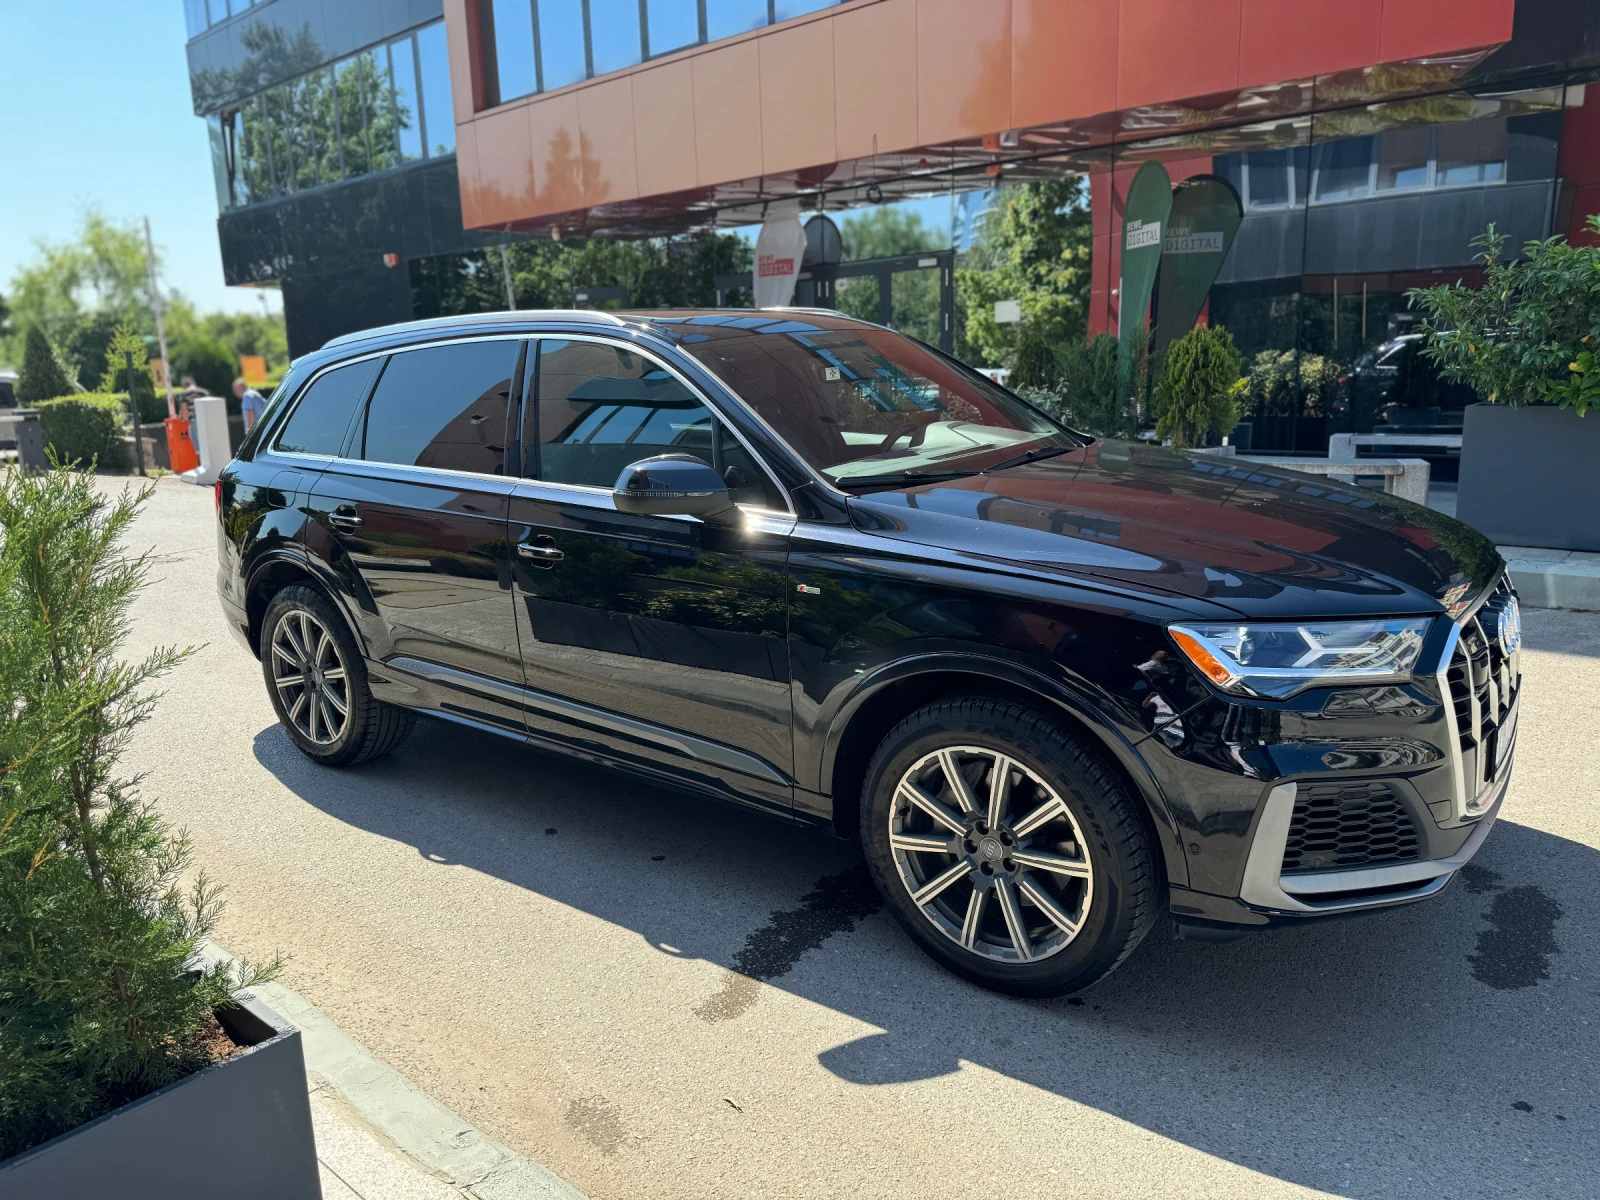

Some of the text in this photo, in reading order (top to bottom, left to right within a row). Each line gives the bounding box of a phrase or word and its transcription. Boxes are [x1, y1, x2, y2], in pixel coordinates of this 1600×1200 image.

[1126, 219, 1142, 231] REWE
[1127, 230, 1159, 247] DIGITAL
[1166, 238, 1220, 251] DIGITAL
[759, 263, 792, 275] DIGITAL
[1058, 772, 1112, 858] SPORT
